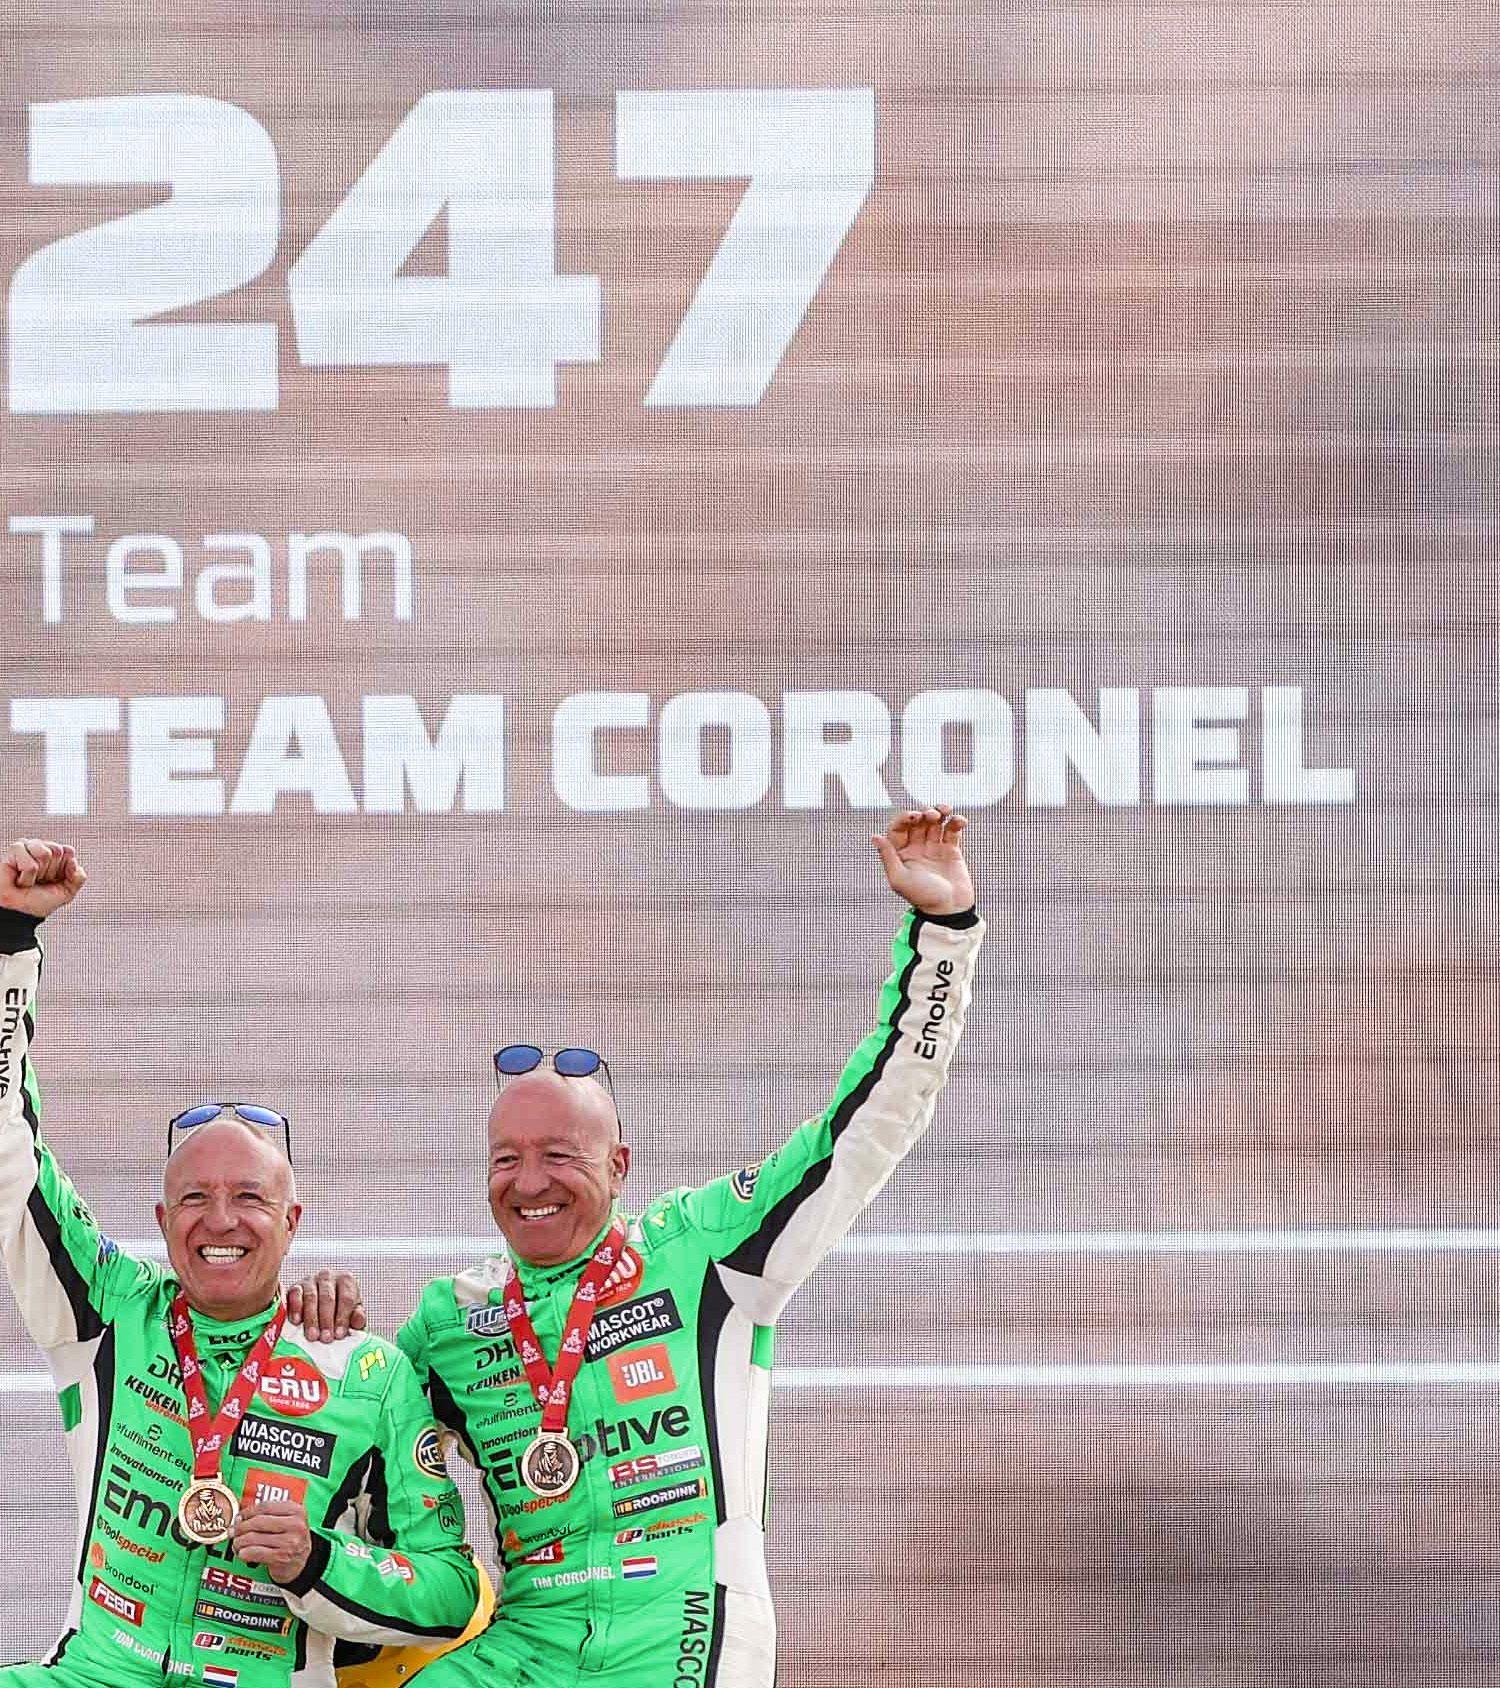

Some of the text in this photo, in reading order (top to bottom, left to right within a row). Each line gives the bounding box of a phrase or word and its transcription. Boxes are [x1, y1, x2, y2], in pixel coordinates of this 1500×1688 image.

[6, 87, 877, 413] 247
[9, 514, 415, 625] Team
[10, 686, 1357, 817] TEAM CORONEL
[913, 957, 954, 1061] Emotive
[589, 1315, 672, 1355] WORKWEAR
[147, 1354, 186, 1393] DH
[473, 1338, 518, 1371] DH
[621, 1357, 665, 1389] JBL
[123, 1374, 182, 1415] KEUKEN
[260, 1375, 322, 1403] ERU
[466, 1365, 522, 1396] KEUKEN
[115, 1421, 192, 1475] efulfilment.eu
[236, 1436, 322, 1471] WORKWEAR
[110, 1442, 185, 1493] innovationsoft
[633, 1484, 698, 1511] ROORDINK
[92, 1583, 137, 1621] FEBO
[532, 1576, 553, 1591] TIM
[214, 1606, 281, 1629] ROORDINK
